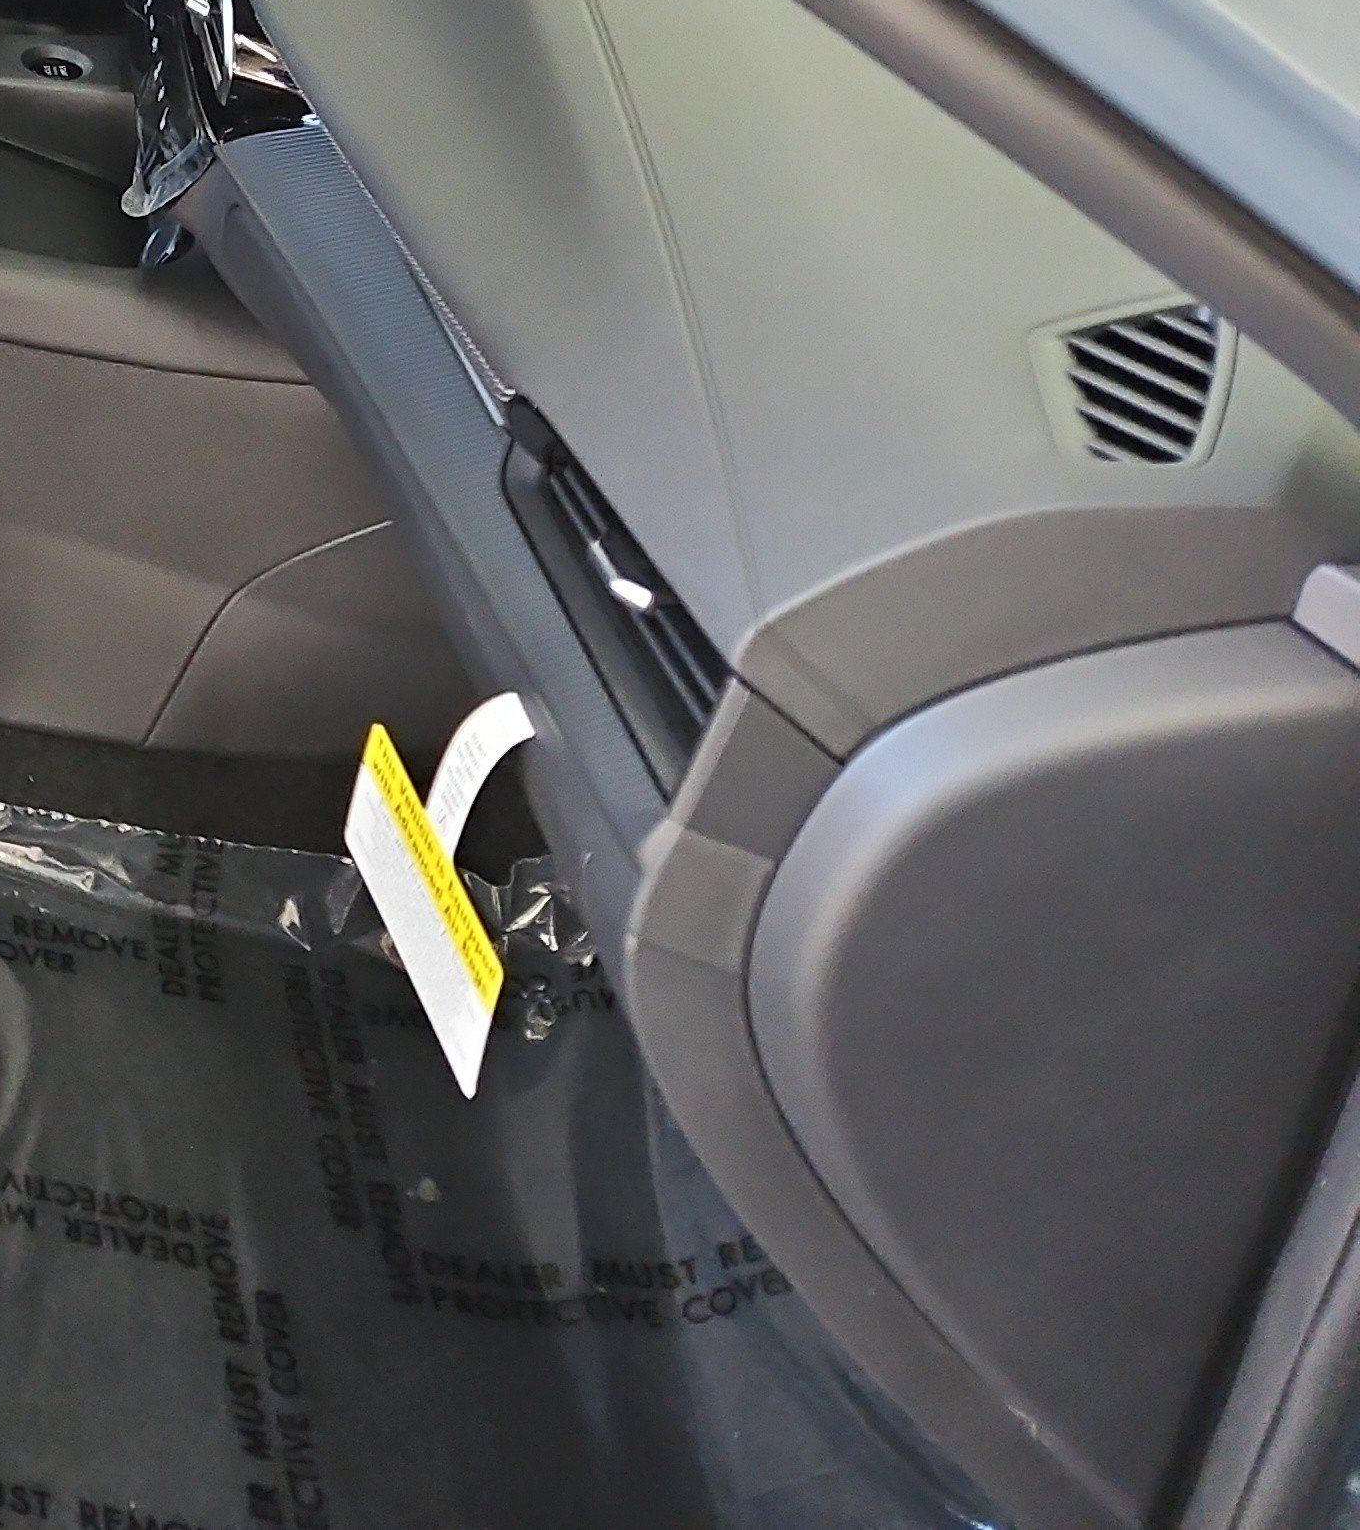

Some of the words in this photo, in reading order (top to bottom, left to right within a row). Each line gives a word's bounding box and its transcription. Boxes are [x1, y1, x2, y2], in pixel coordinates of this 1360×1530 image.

[376, 735, 397, 780] This
[397, 777, 436, 857] Vehicle
[445, 878, 498, 986] Equipped
[393, 798, 444, 903] Advanced
[12, 913, 148, 962] REMOVE
[152, 900, 188, 998] DEALE
[63, 1214, 197, 1271] DEALER
[200, 1212, 251, 1346] REMOVE
[255, 1289, 301, 1398] COVER
[224, 1360, 271, 1462] MUST
